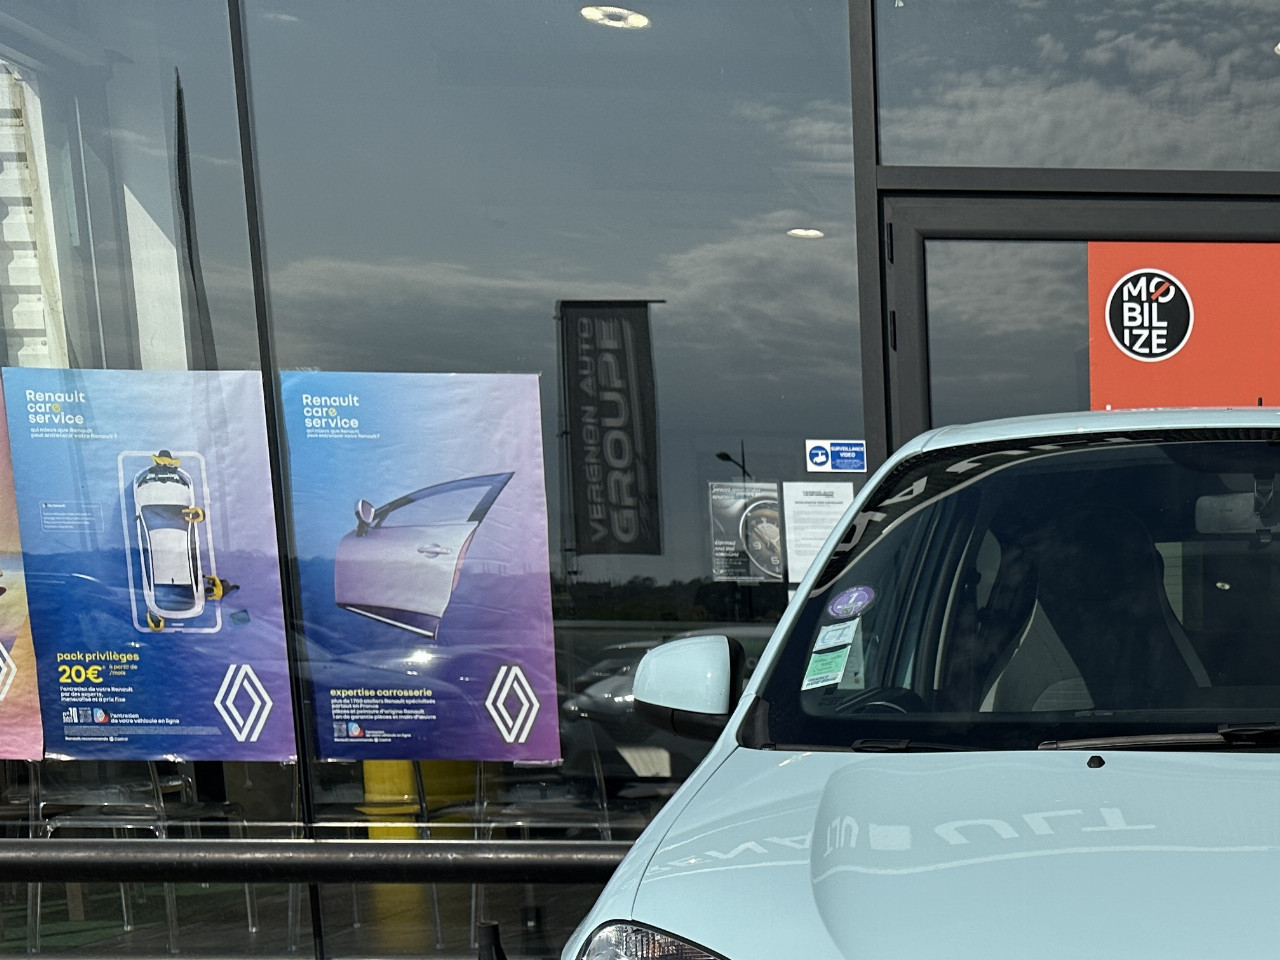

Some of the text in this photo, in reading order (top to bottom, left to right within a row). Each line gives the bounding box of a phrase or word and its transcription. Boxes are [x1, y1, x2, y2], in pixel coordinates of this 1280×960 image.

[25, 389, 85, 403] Renault
[302, 394, 360, 407] Renault
[27, 402, 61, 413] care
[303, 406, 337, 417] care
[28, 411, 84, 425] service
[305, 416, 359, 428] service
[594, 317, 641, 544] GROUPE
[57, 651, 140, 663] pack privilèges
[58, 665, 104, 683] 20€
[330, 688, 433, 698] expertise carrosserie
